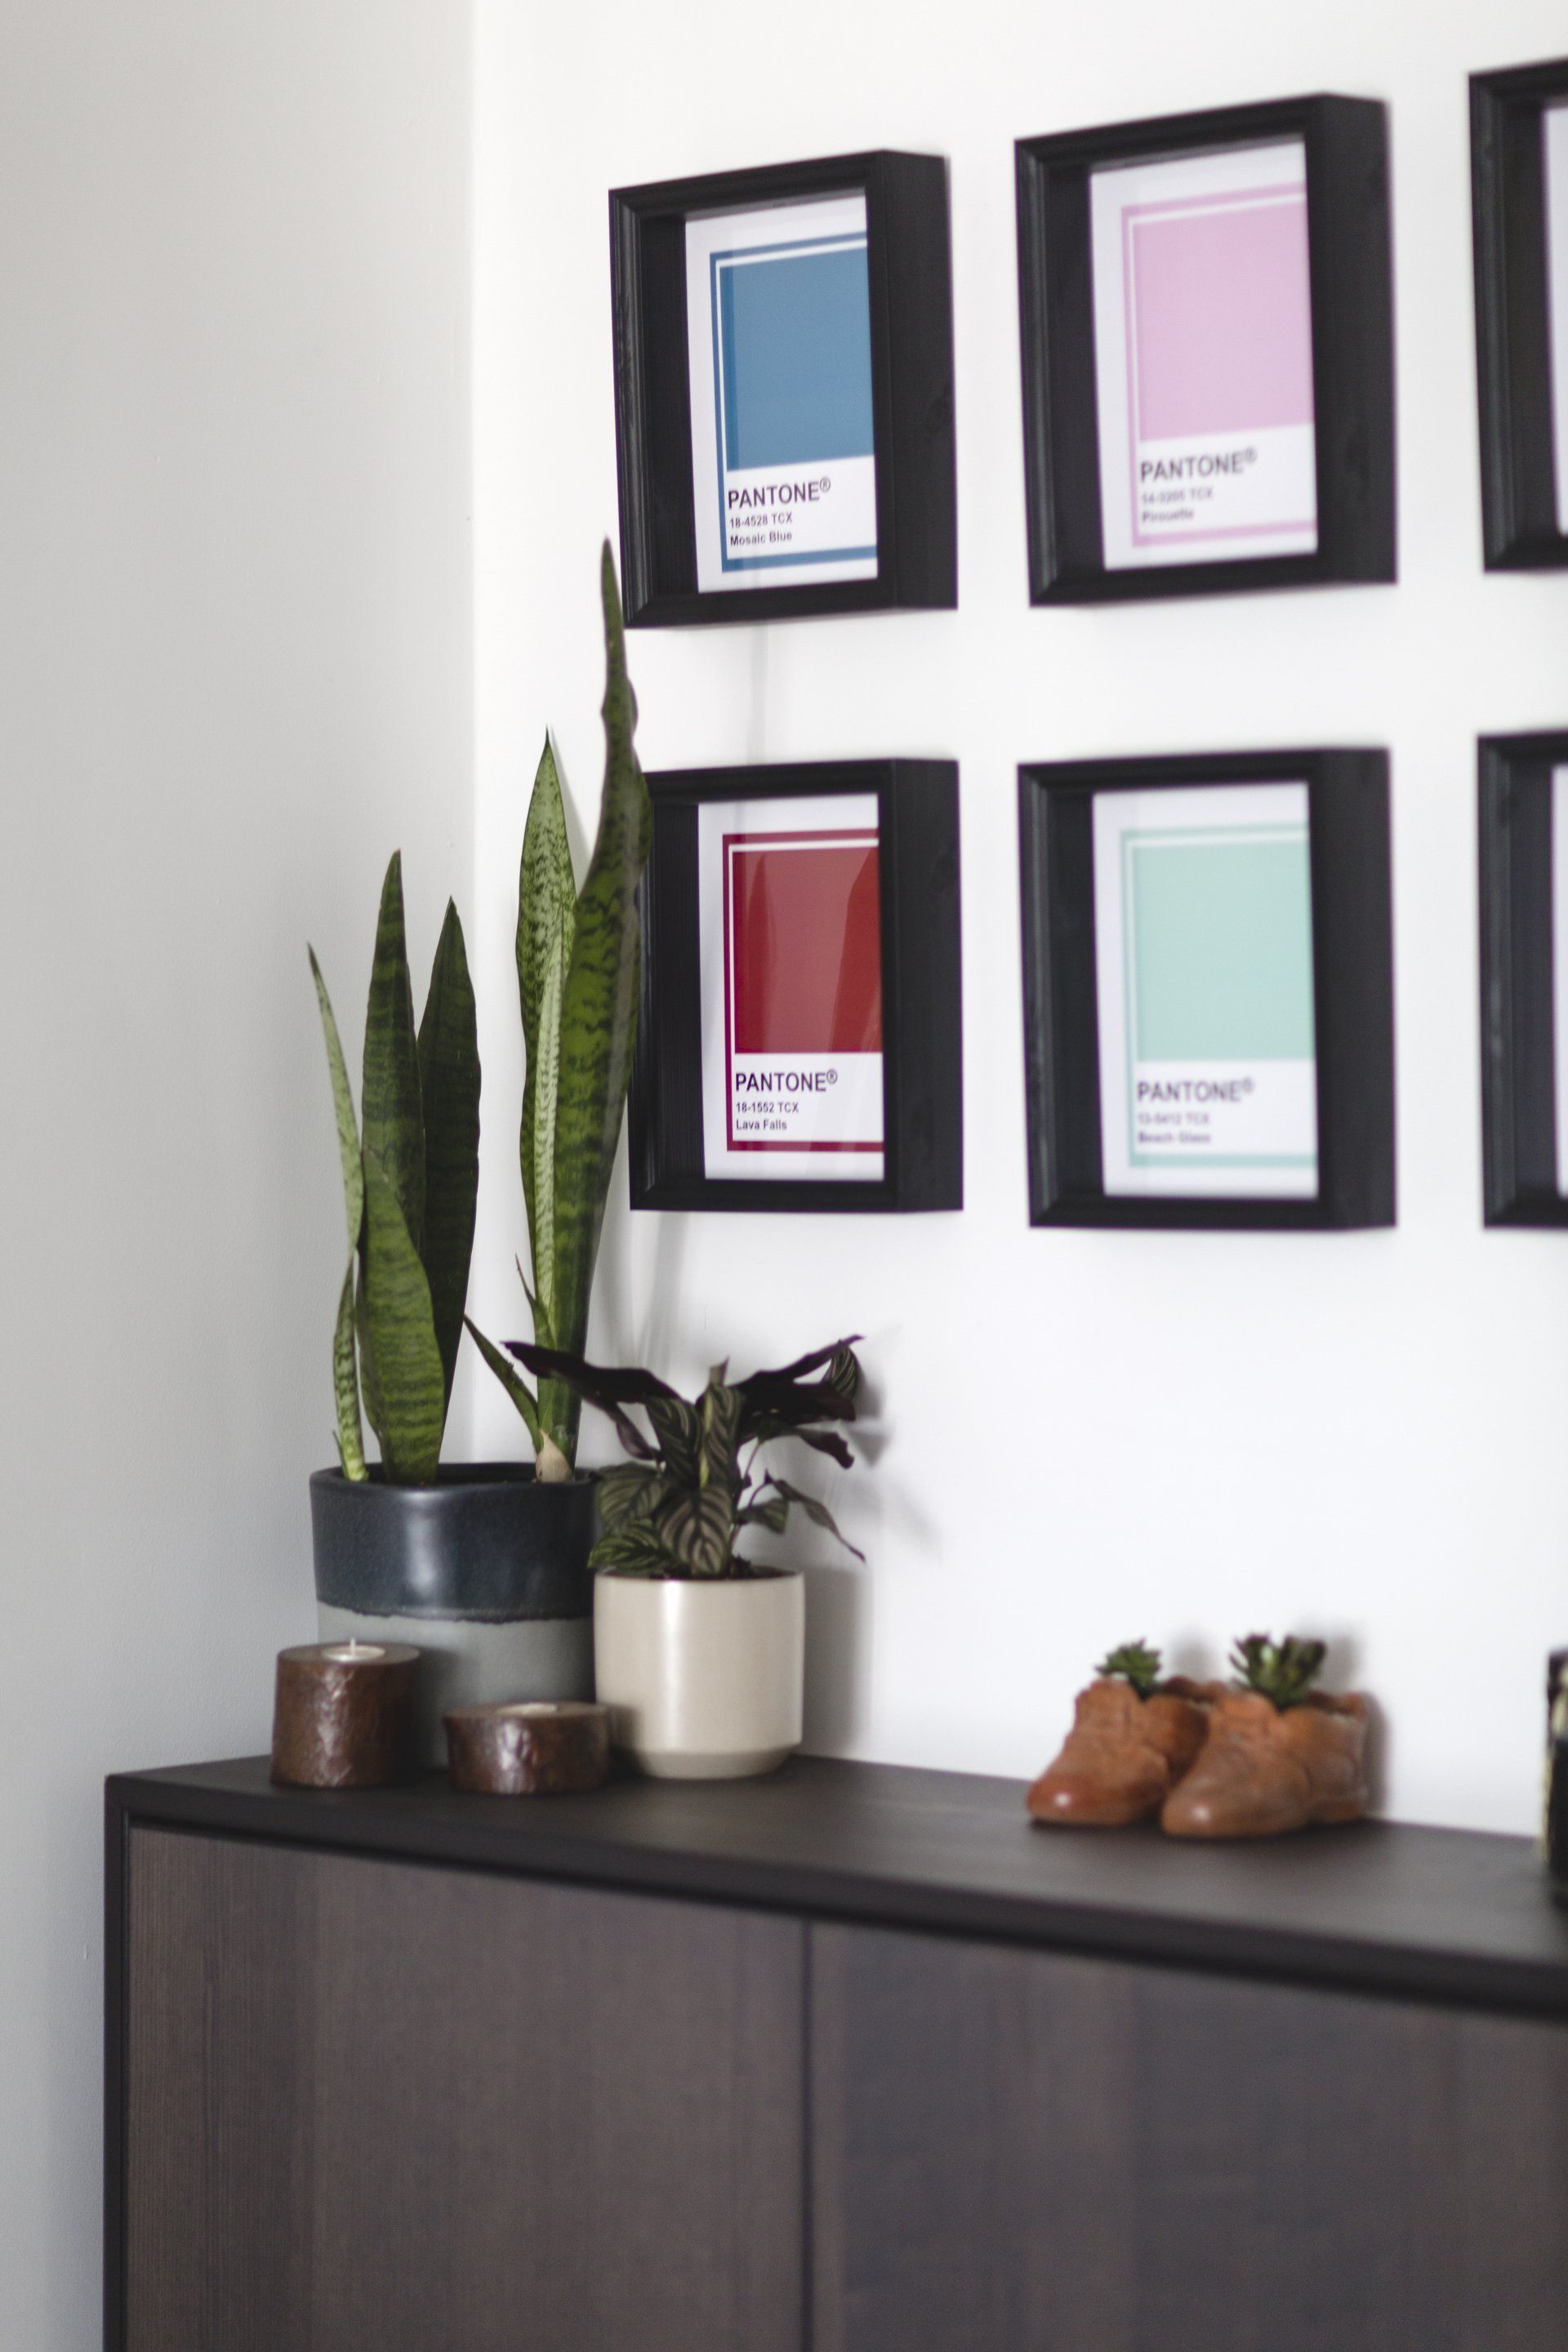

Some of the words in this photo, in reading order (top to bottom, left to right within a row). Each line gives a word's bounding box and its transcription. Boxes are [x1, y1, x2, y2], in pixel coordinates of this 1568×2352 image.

[729, 514, 768, 528] 18-4528
[772, 512, 793, 524] TCX
[730, 533, 766, 546] Mosaic
[768, 531, 792, 543] Blue
[736, 1102, 775, 1113] 18-1552
[777, 1102, 799, 1113] TCX
[736, 1119, 760, 1130] Lava
[763, 1119, 787, 1130] Falls
